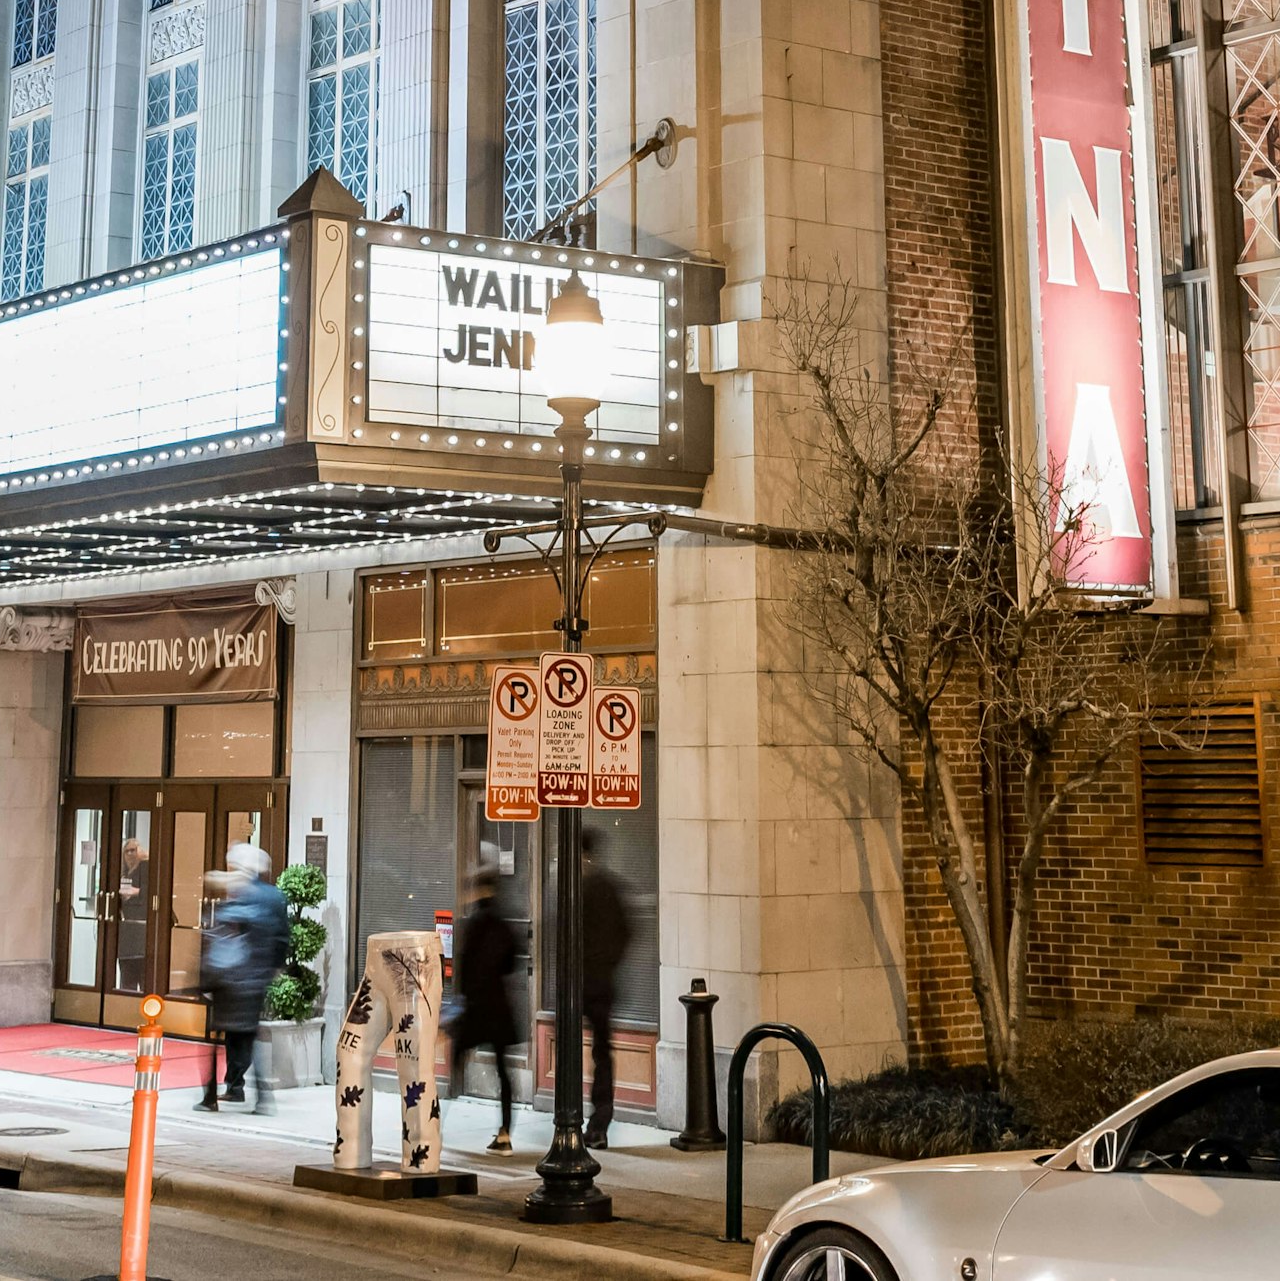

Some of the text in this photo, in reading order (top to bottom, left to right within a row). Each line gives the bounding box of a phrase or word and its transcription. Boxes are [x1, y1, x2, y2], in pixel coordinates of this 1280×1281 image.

[83, 627, 268, 675] CELEBRATING 90 YEARS
[546, 710, 583, 719] LOADING
[553, 721, 576, 730] ZONE
[497, 727, 534, 738] Valet Parking
[508, 738, 522, 749] Only
[600, 742, 630, 753] 6 P.M.
[497, 750, 512, 758] Permit
[545, 762, 581, 771] 6AM-6PM
[600, 764, 629, 773] 6 A.M.
[540, 774, 587, 791] TOW-IN
[594, 776, 638, 791] TOW-IN
[491, 787, 537, 804] TOW-IN
[339, 1030, 361, 1049] ITE
[394, 1038, 412, 1054] AK
